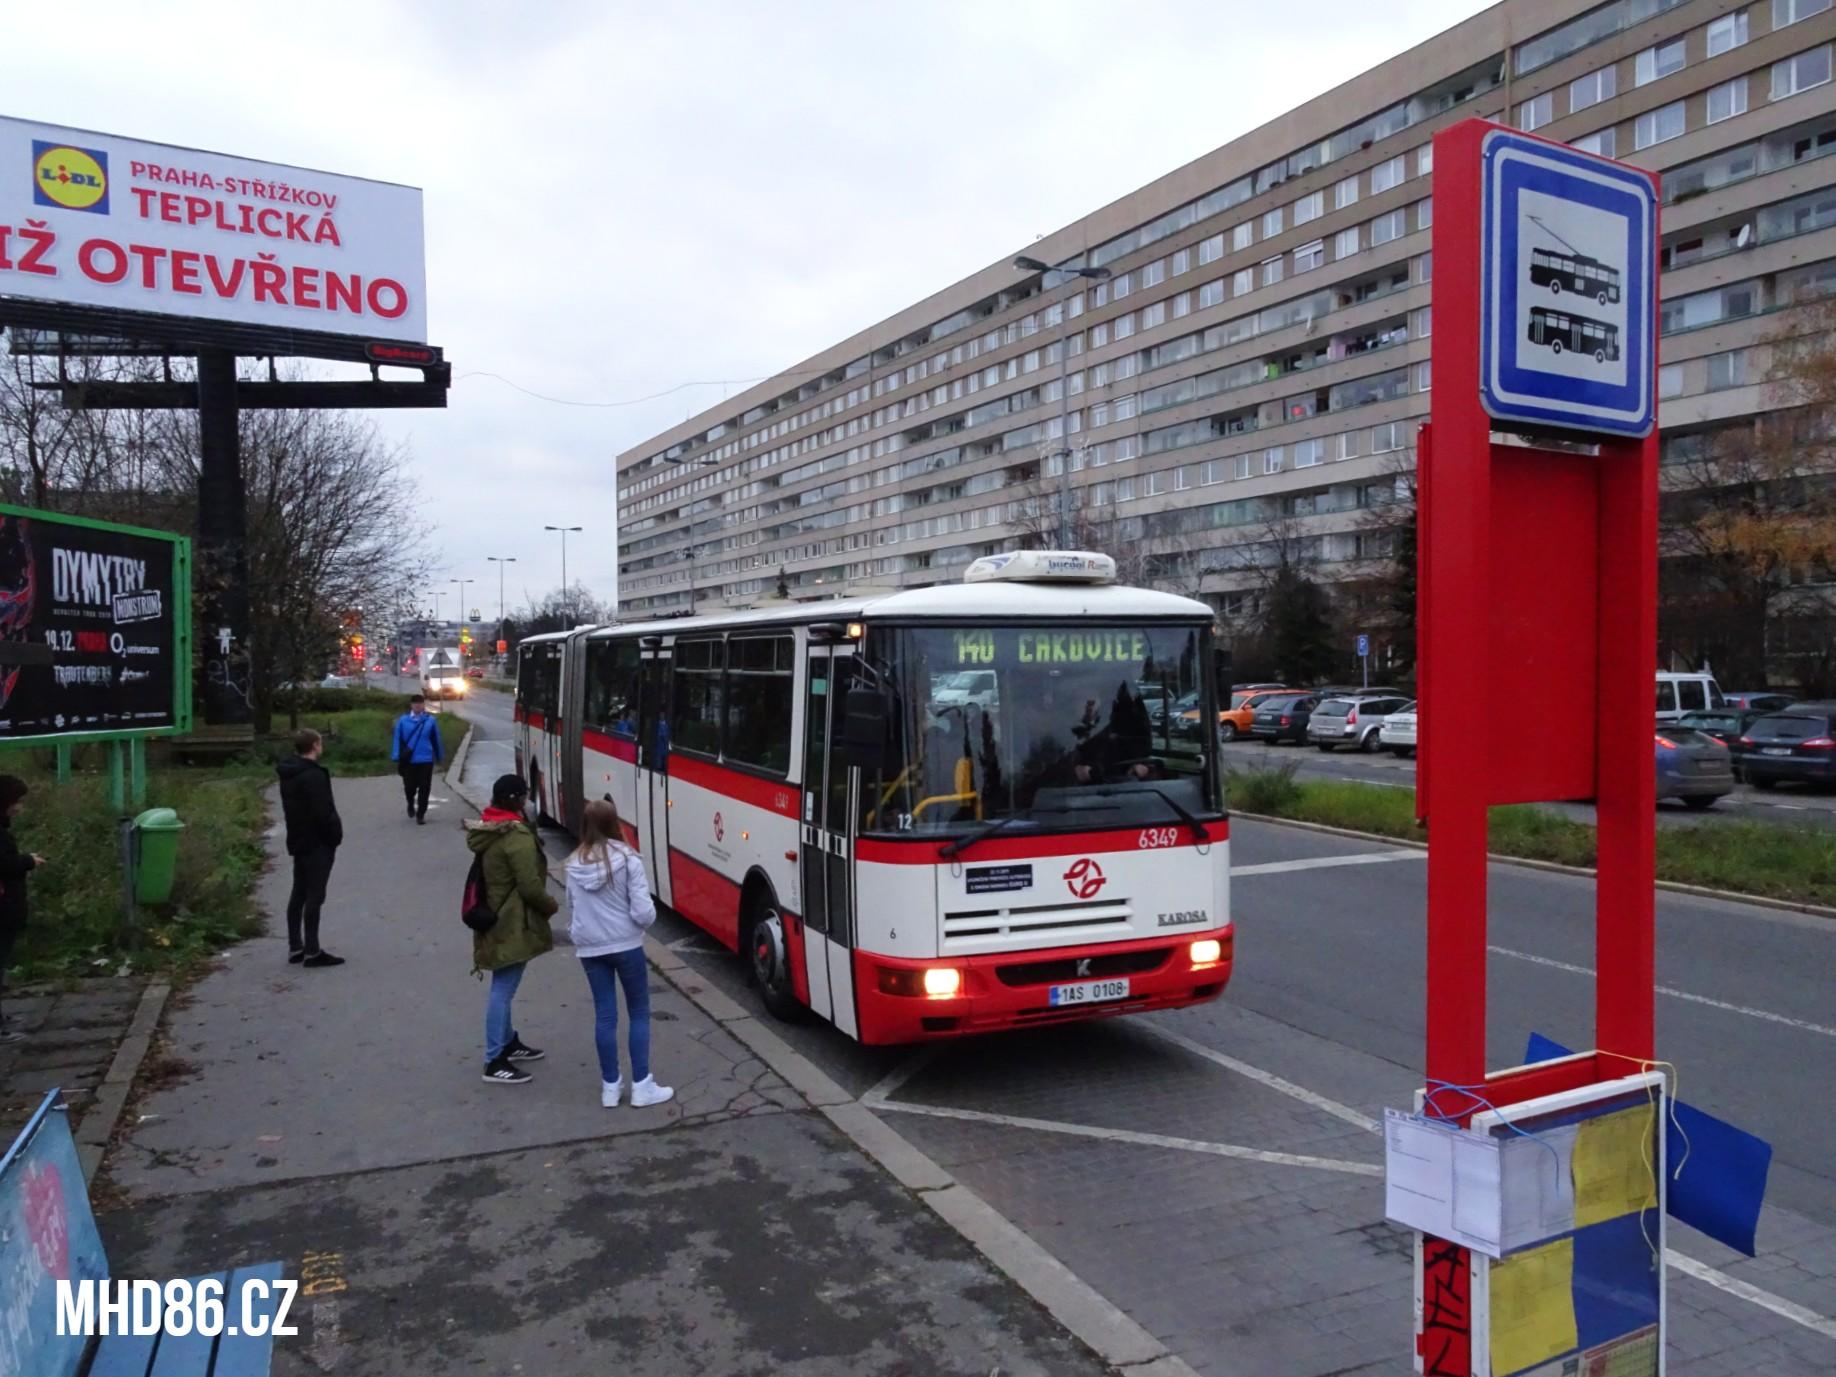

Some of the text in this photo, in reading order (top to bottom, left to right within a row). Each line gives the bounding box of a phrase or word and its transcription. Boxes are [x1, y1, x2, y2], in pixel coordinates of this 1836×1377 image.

[129, 160, 337, 210] PRAHA-STŘÍŽKOV
[131, 187, 341, 247] TEPLICKÁ
[78, 237, 408, 319] OTEVŘENO
[53, 548, 145, 605] DYMYTRY
[117, 595, 160, 619] MONSTRUM
[45, 629, 76, 652] 19.12.
[953, 629, 995, 664] 140
[897, 814, 913, 831] 12
[1138, 827, 1178, 848] 6349
[1157, 910, 1208, 927] KAROSA
[890, 927, 897, 940] 6
[1063, 981, 1123, 1001] 1AS 0108
